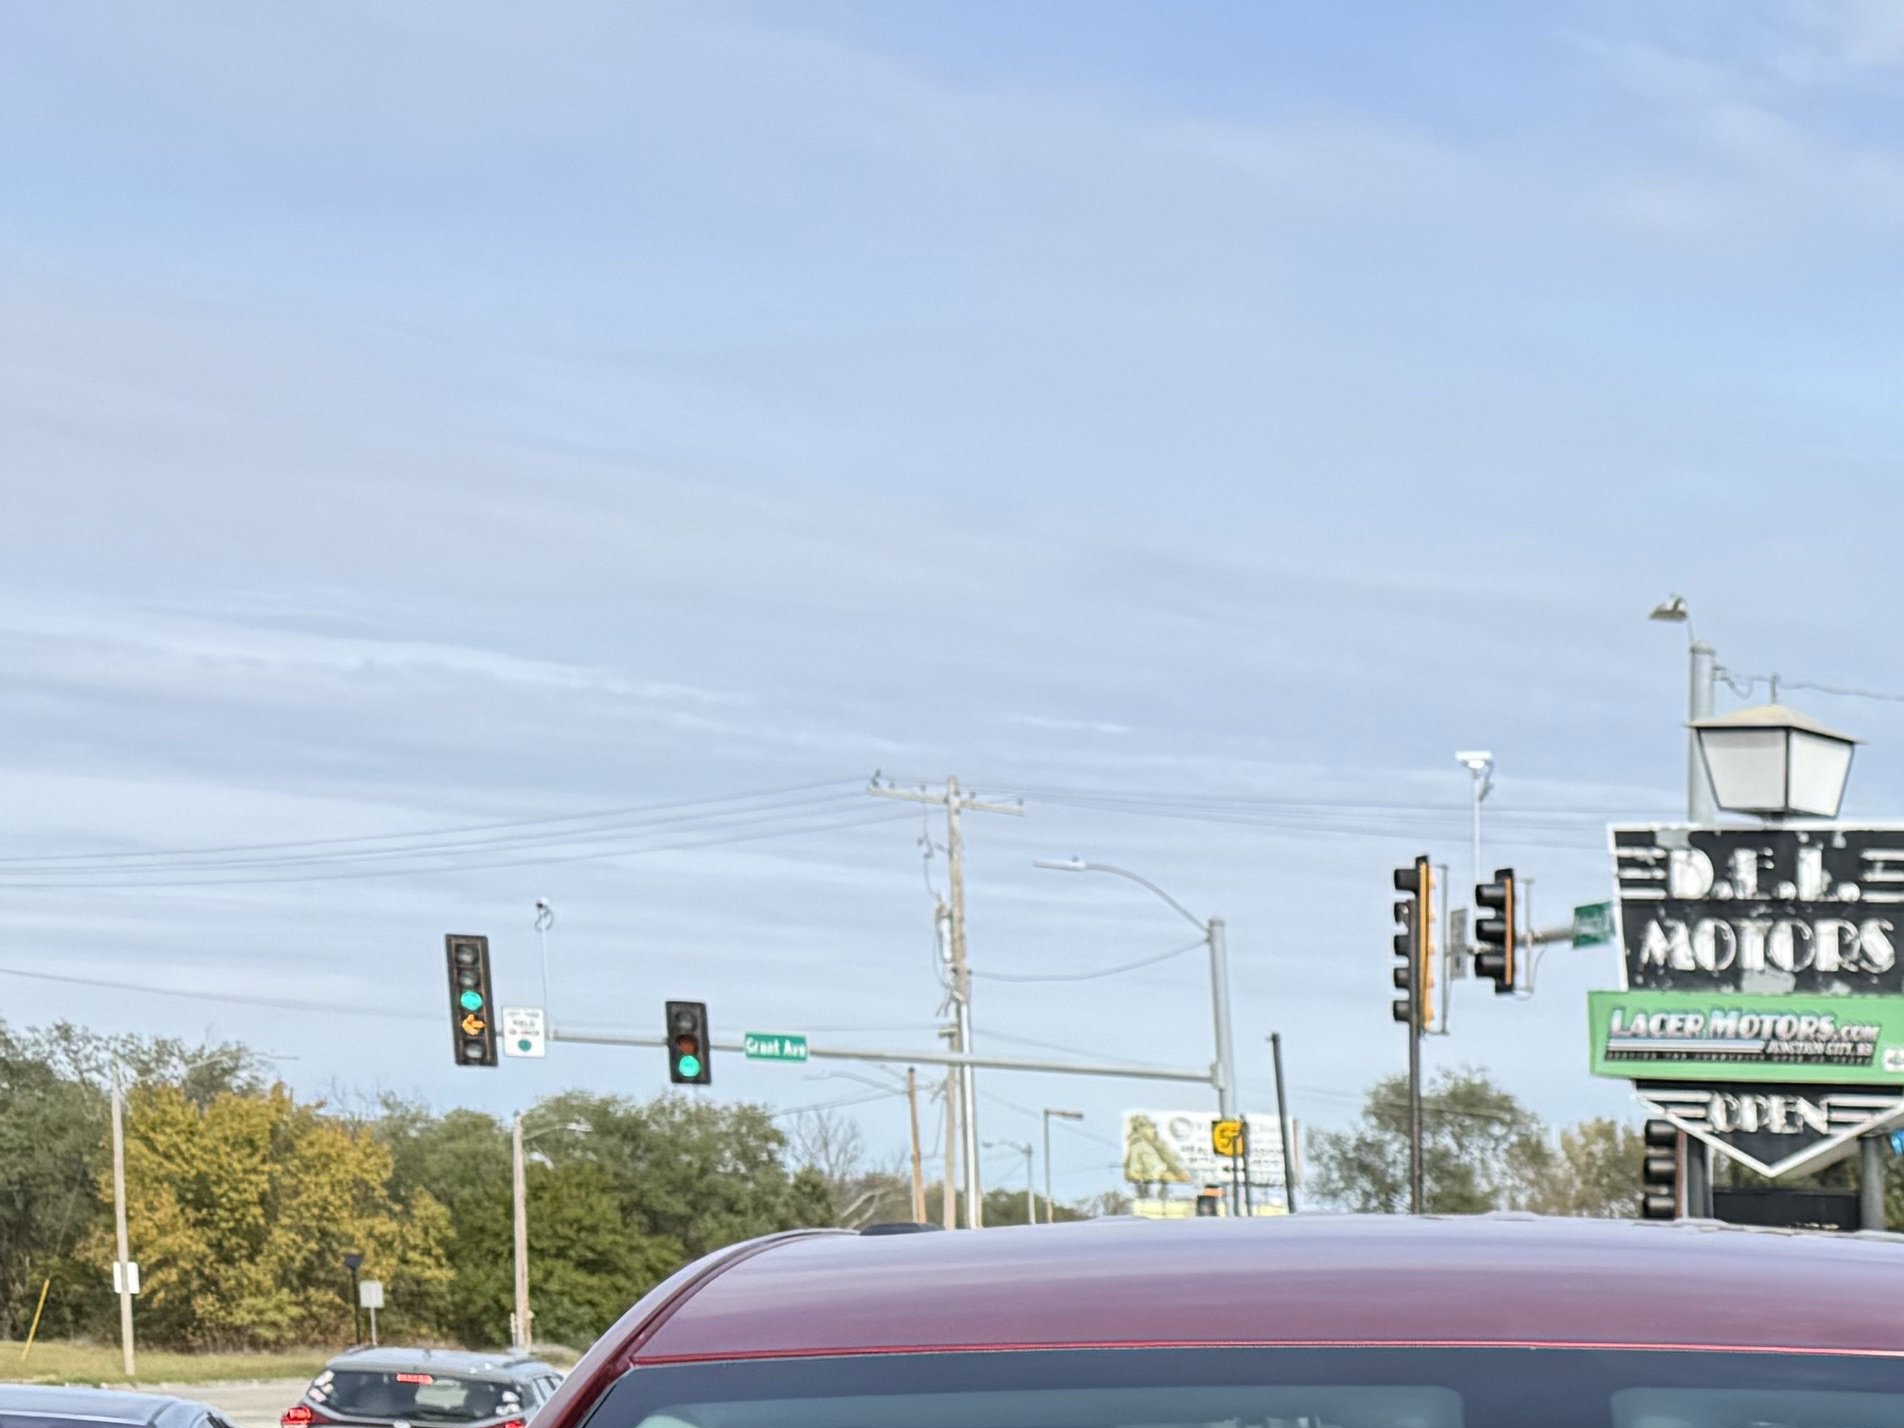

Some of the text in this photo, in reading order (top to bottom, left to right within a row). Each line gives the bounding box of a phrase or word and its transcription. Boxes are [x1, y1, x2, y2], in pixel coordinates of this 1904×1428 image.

[1637, 916, 1897, 974] MOTORS
[1611, 1009, 1704, 1039] LACER
[745, 1036, 807, 1058] Grant Ave
[1708, 1091, 1829, 1136] OPEN
